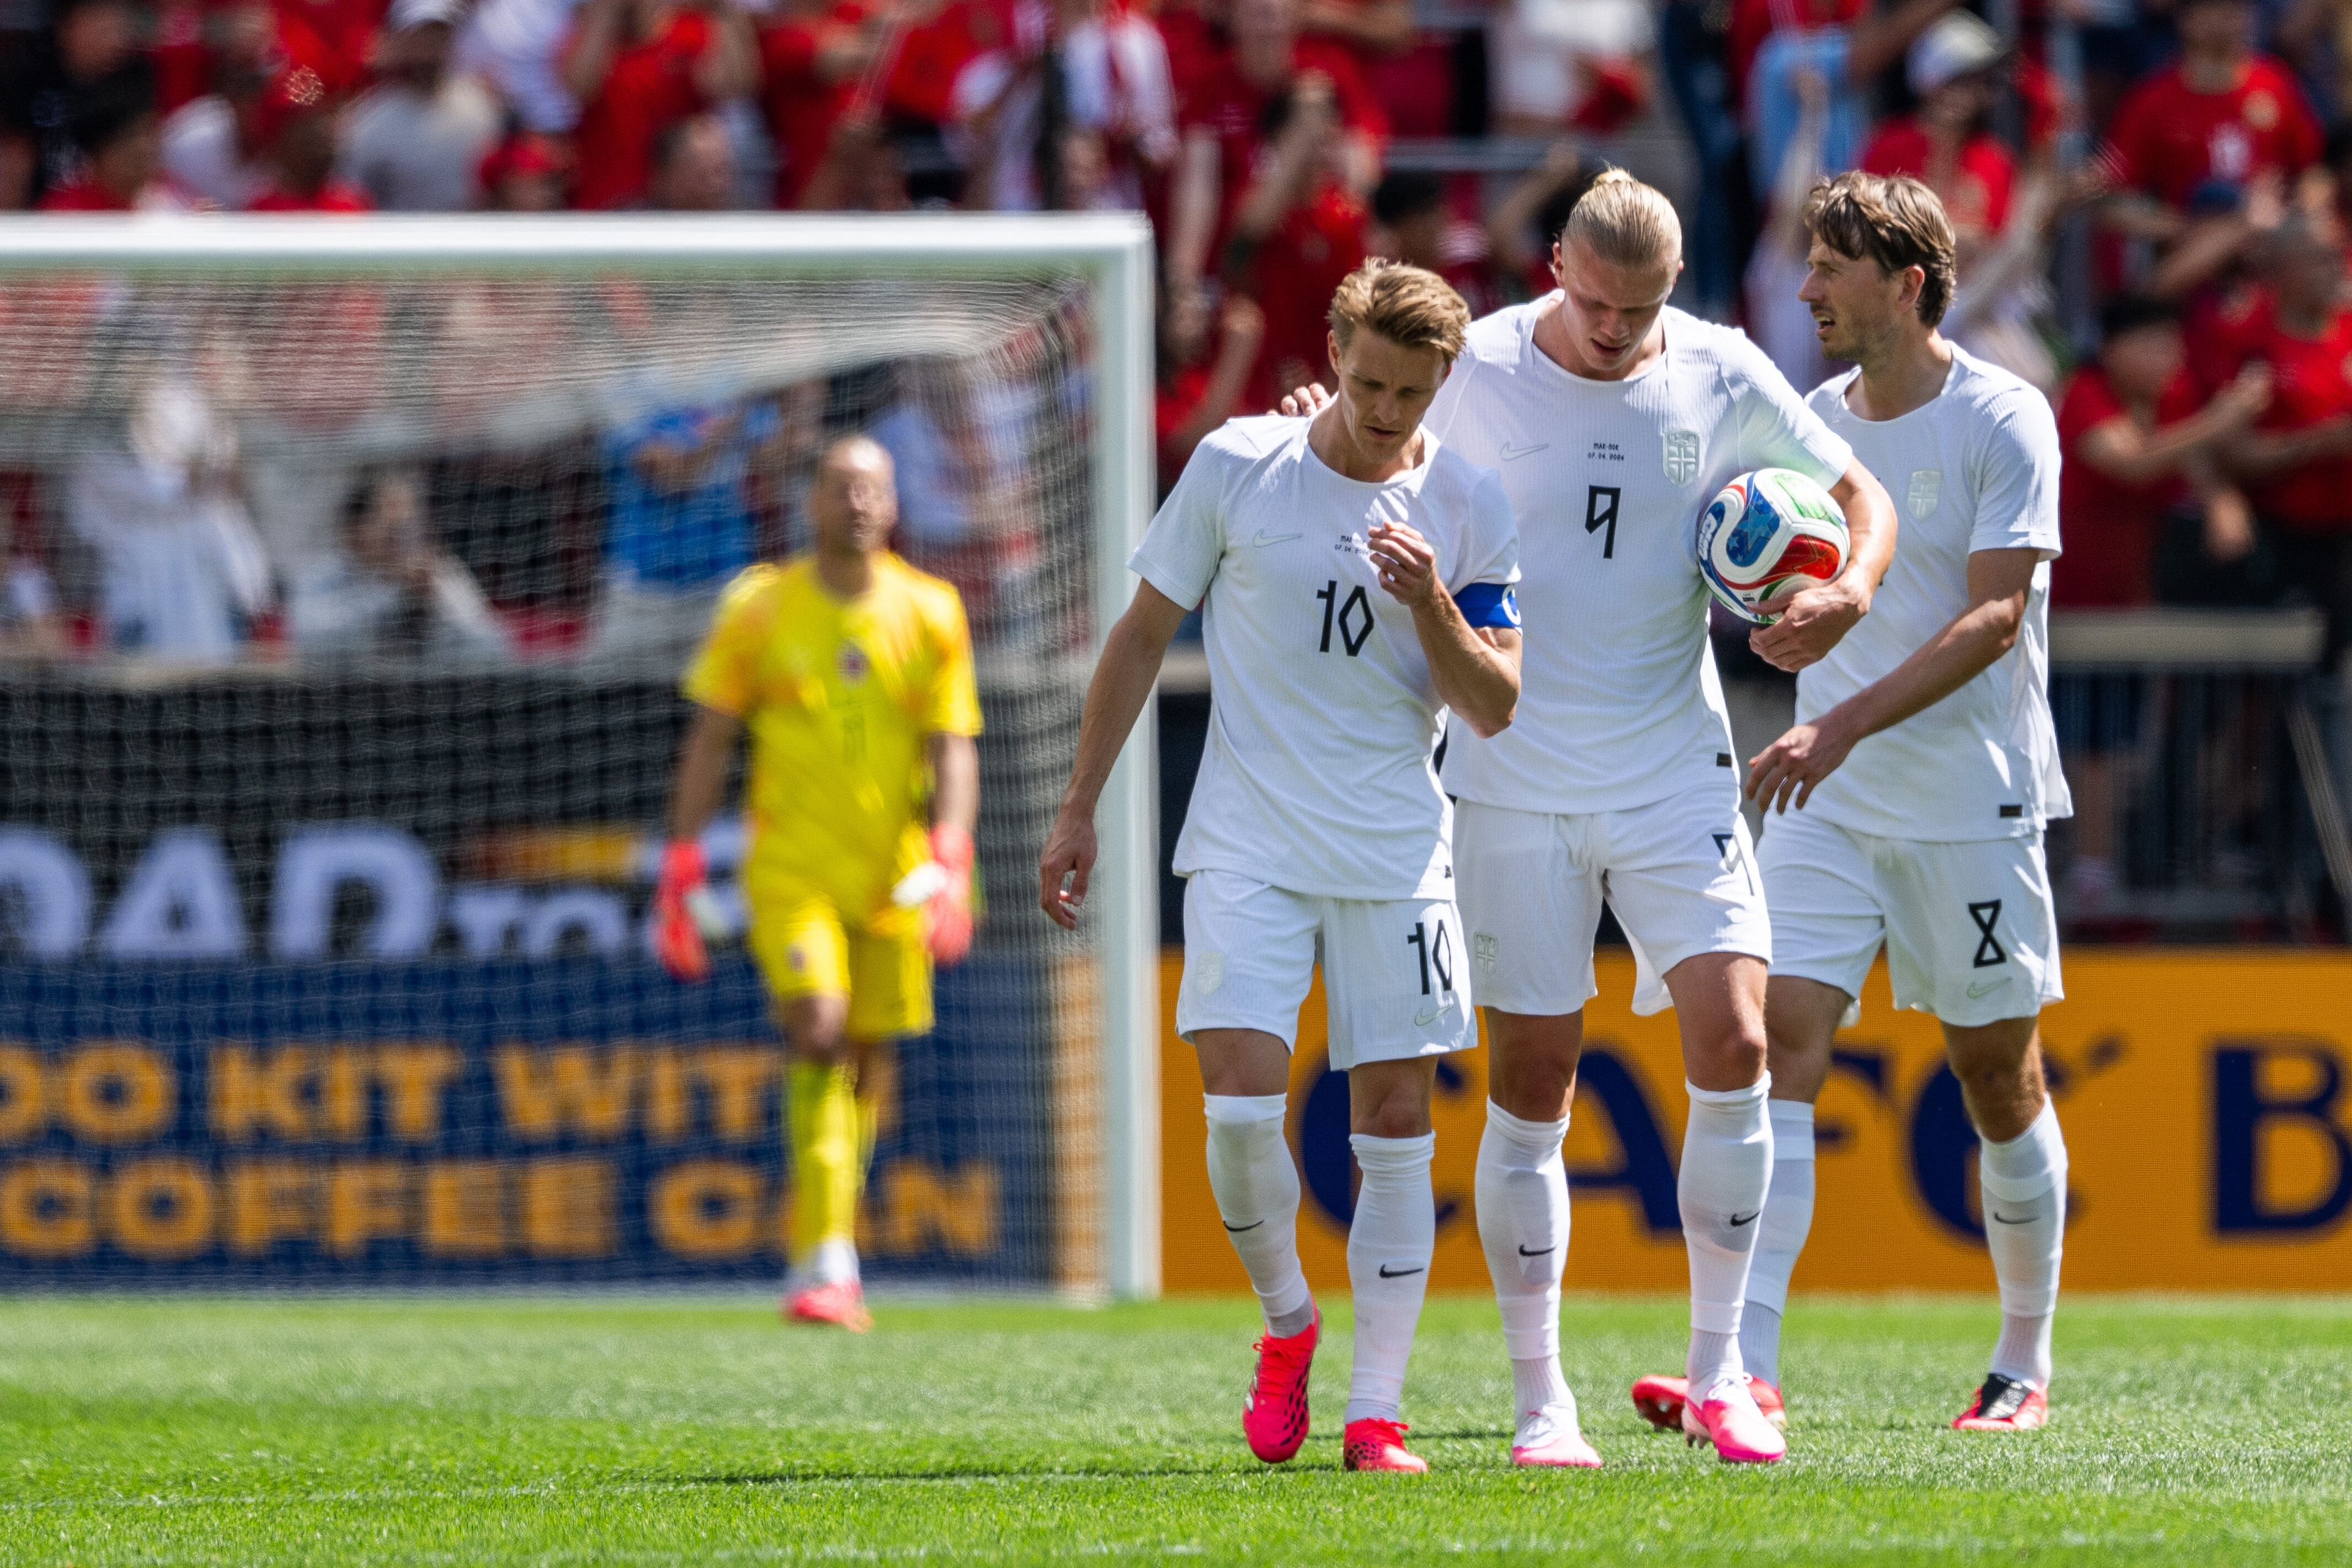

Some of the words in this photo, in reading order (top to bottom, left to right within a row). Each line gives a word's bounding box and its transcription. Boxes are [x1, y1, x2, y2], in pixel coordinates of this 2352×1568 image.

[1585, 484, 1622, 559] 9
[1317, 580, 1374, 657] 10
[1407, 919, 1453, 996] 10
[1968, 899, 2007, 968] 8
[209, 1040, 462, 1140] KIT
[494, 1040, 900, 1142] WIT
[0, 1156, 616, 1261] COFFEE
[646, 1156, 1005, 1261] CN
